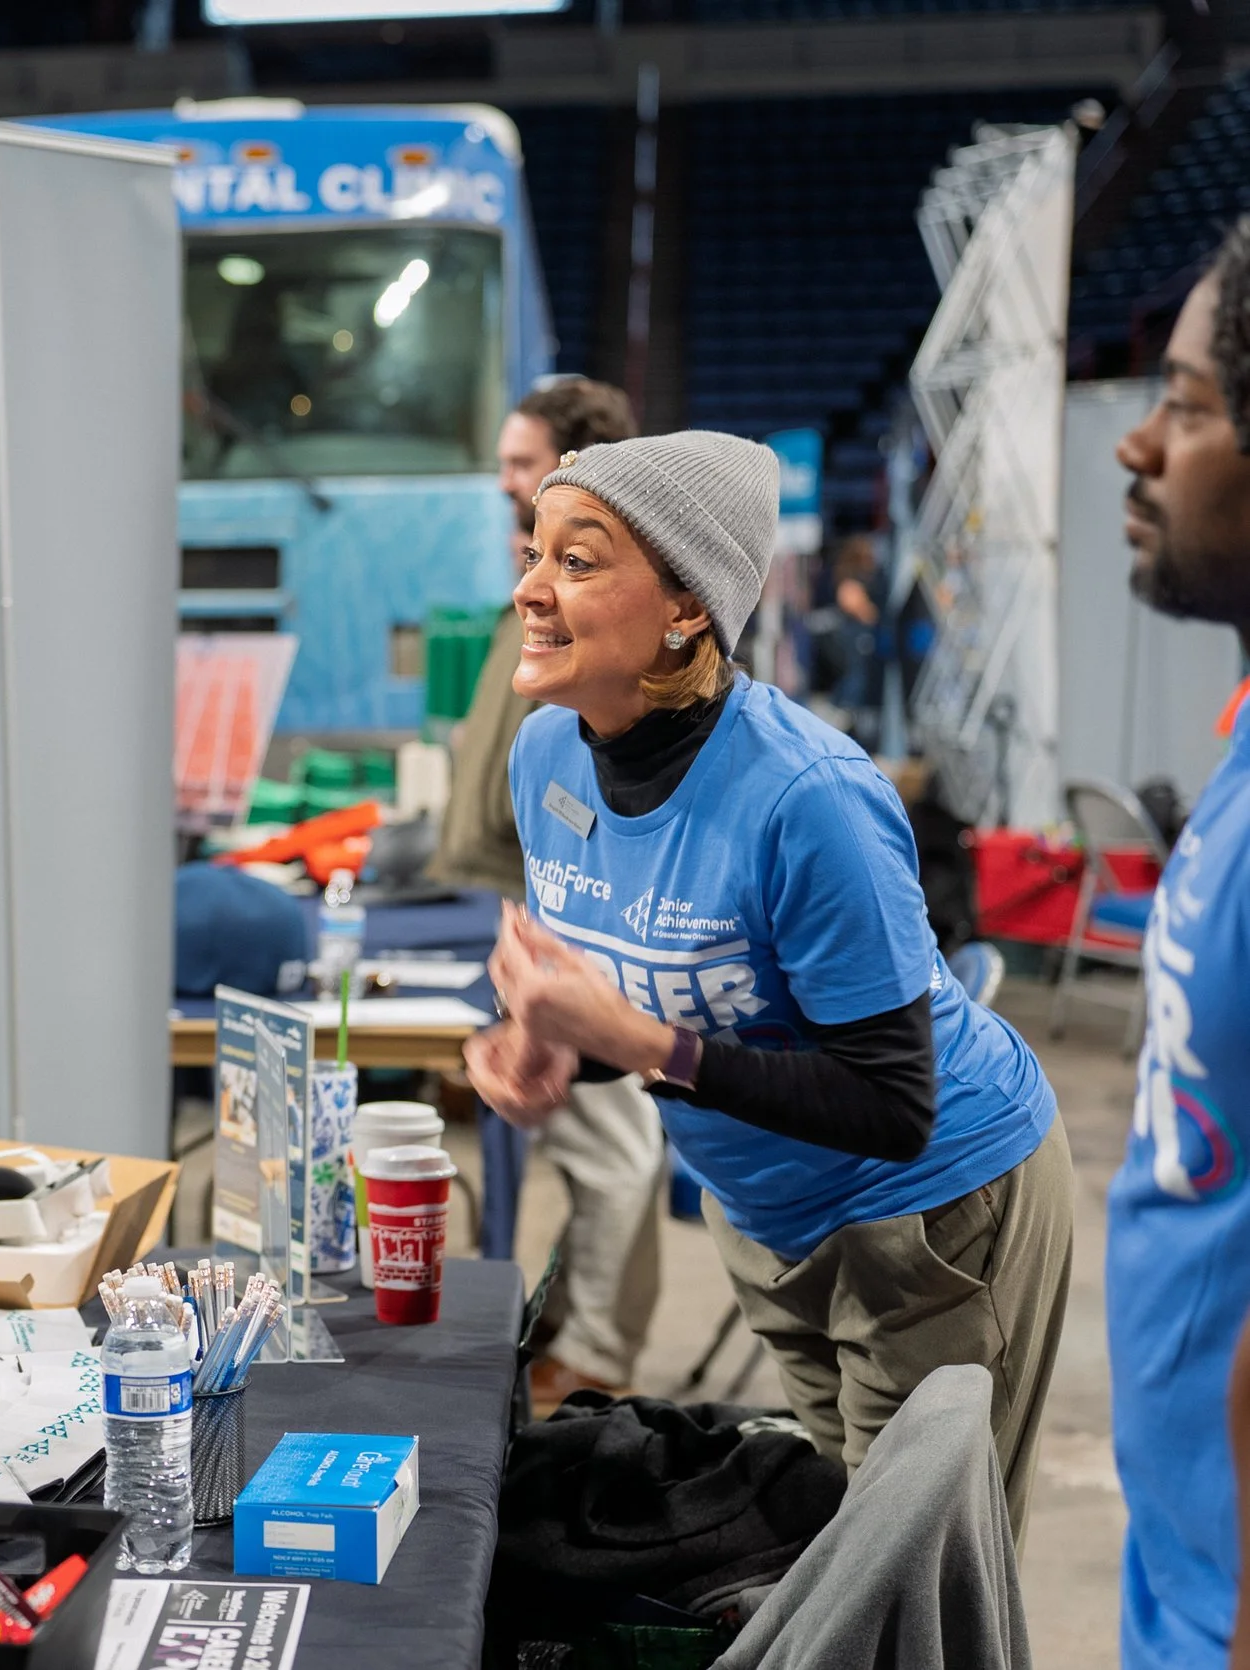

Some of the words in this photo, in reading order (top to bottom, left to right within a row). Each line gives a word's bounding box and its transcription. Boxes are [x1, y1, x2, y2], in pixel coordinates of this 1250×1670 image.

[657, 896, 694, 913] Junior
[654, 913, 737, 932] Achievement
[271, 1509, 305, 1518] ALCOHOL
[250, 1590, 289, 1646] Welcome
[150, 1625, 211, 1670] EXP
[196, 1627, 243, 1670] CARE
